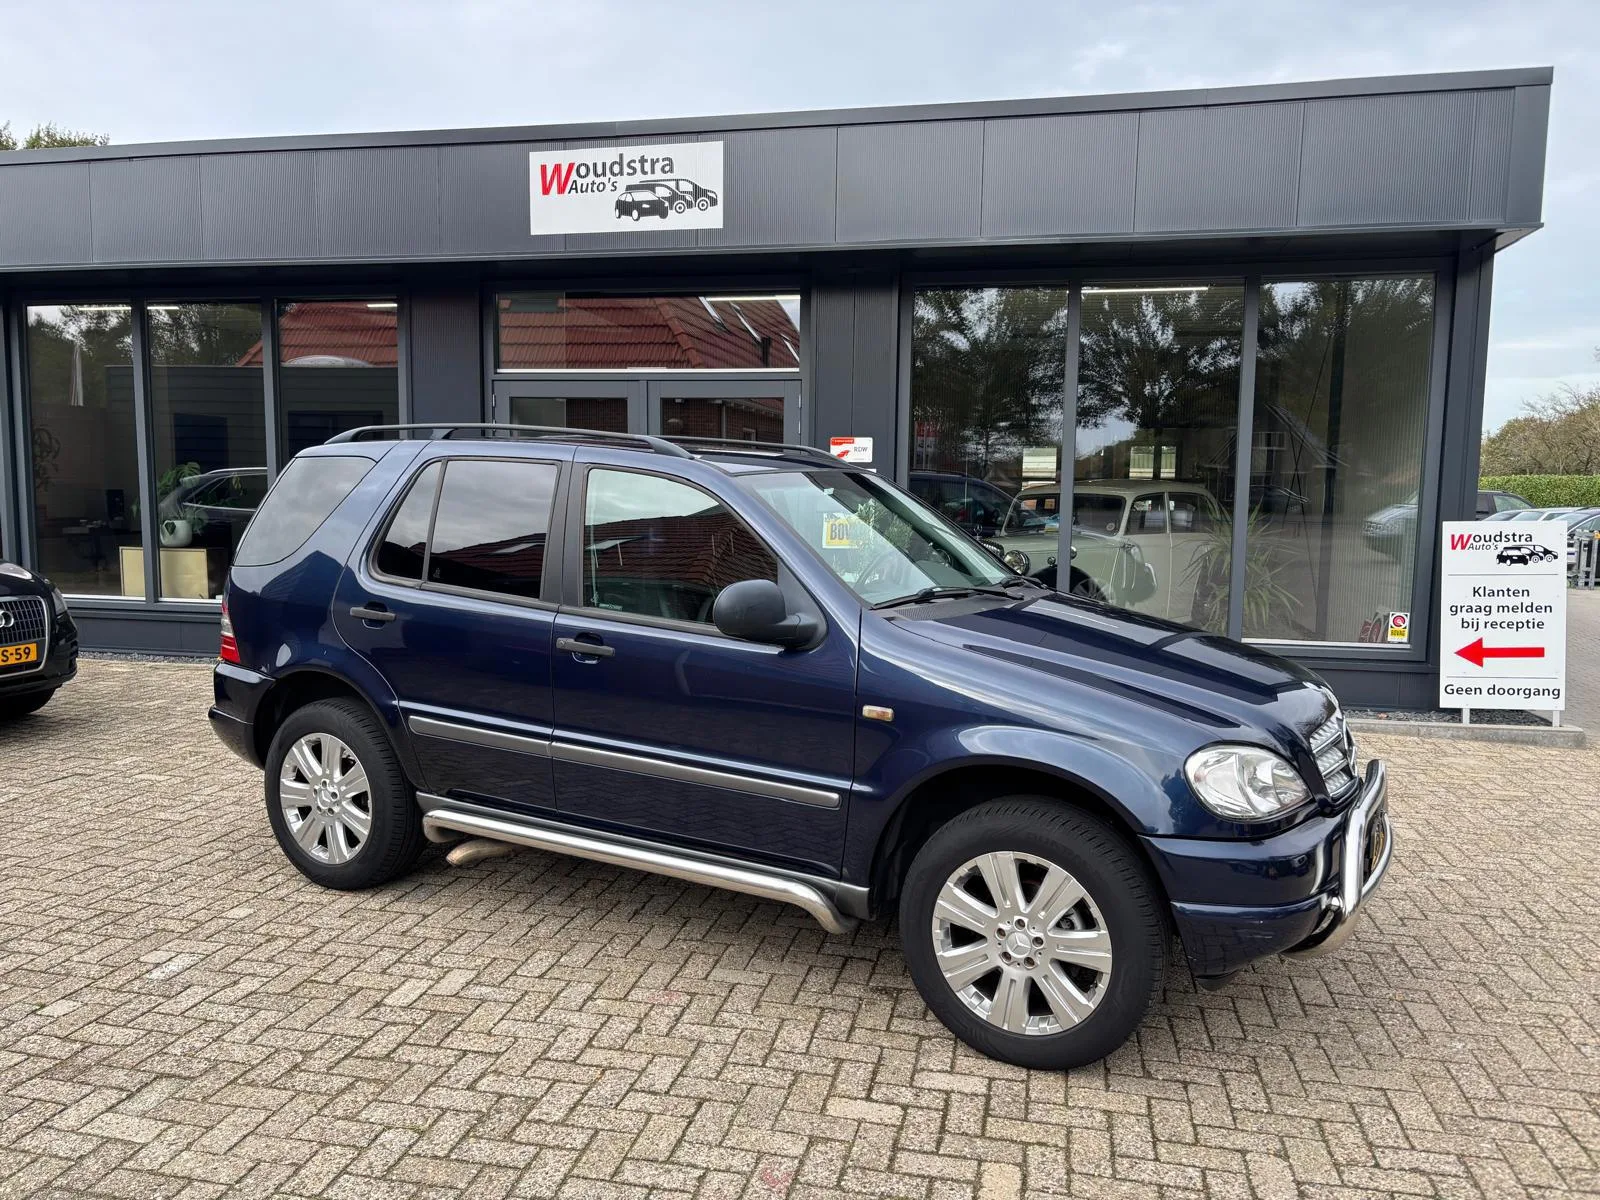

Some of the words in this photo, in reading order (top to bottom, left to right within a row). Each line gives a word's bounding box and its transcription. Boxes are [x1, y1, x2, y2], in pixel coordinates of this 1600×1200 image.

[540, 153, 675, 196] Woudstra
[567, 178, 618, 195] Auto's
[1450, 531, 1533, 551] Woudstra
[1467, 542, 1499, 551] Auto's
[1472, 586, 1530, 598] Klanten
[1449, 604, 1492, 616] graag
[1496, 602, 1553, 614] melden
[1461, 618, 1480, 632] bij
[1484, 618, 1545, 632] receptie
[1, 647, 31, 663] S-59
[1444, 684, 1483, 696] Geen
[1486, 684, 1561, 699] doorgang
